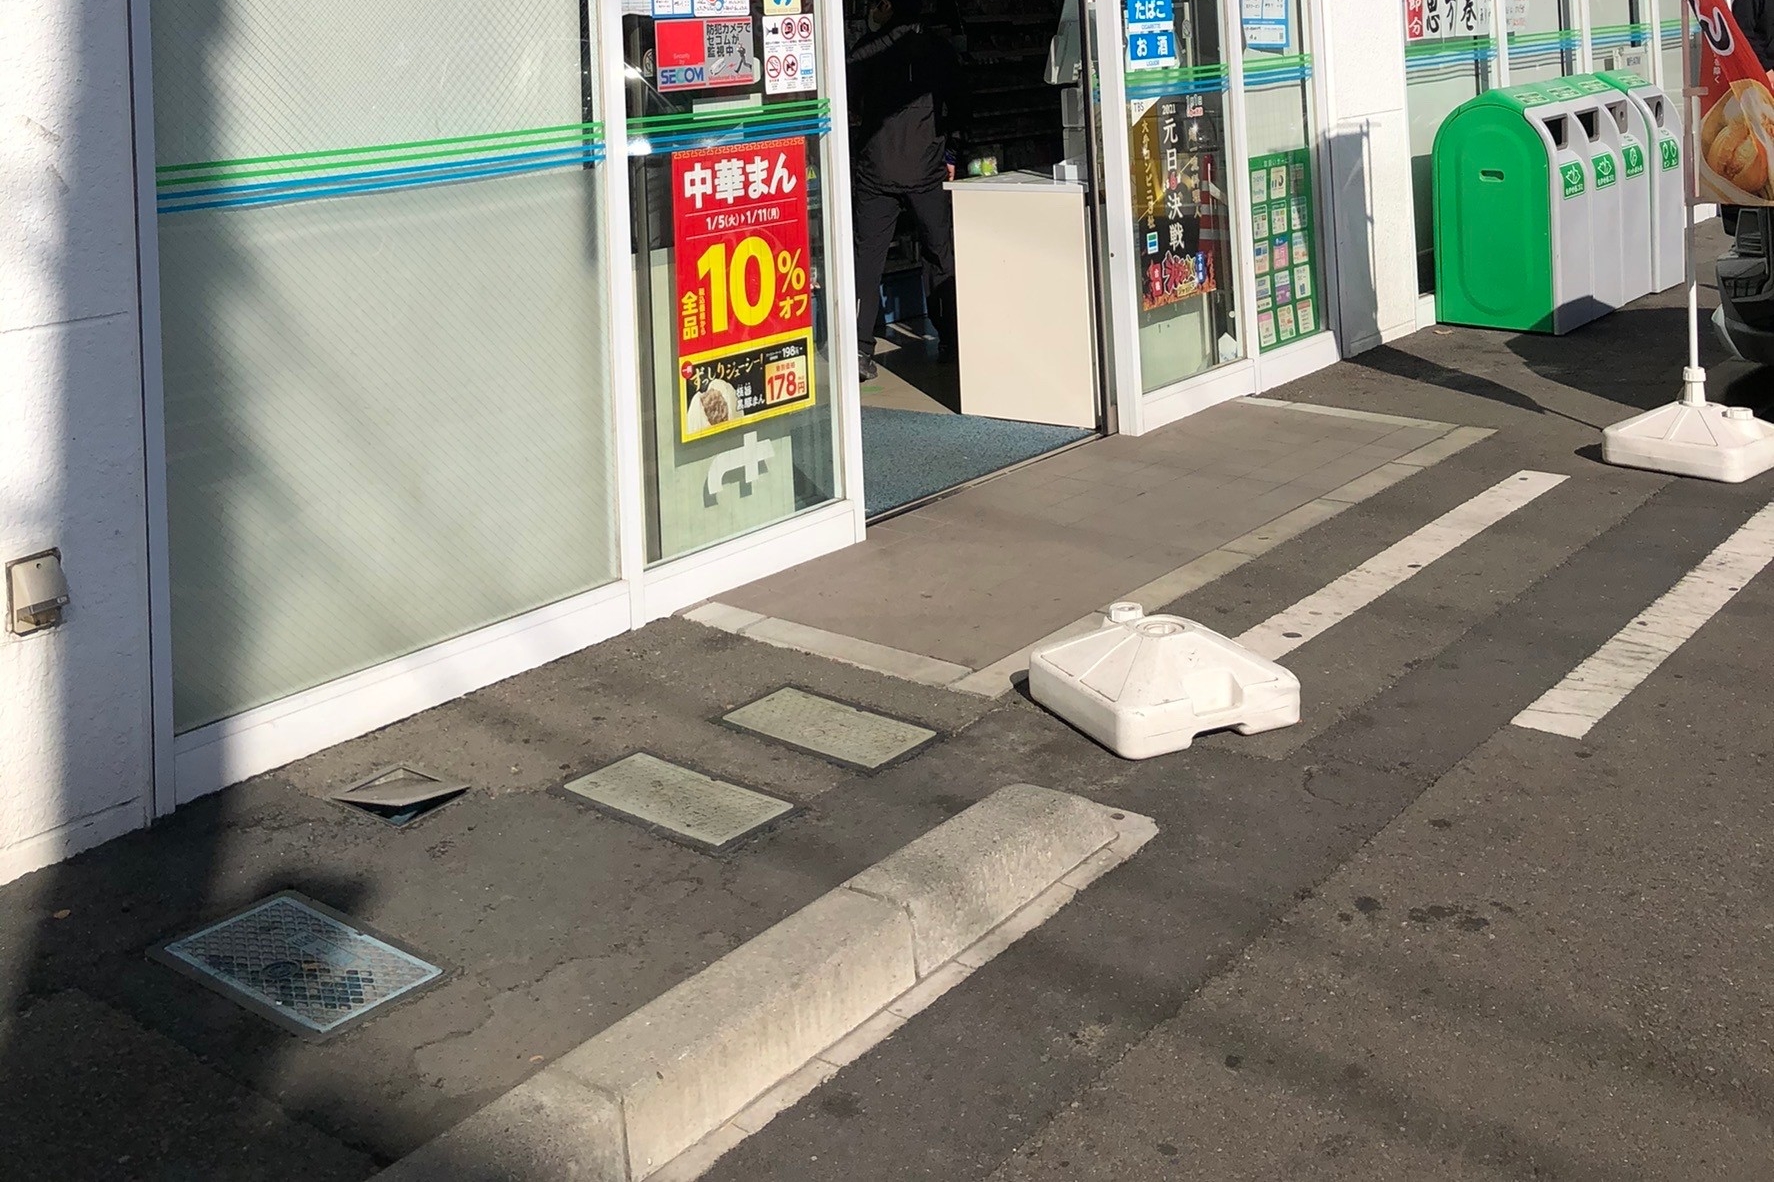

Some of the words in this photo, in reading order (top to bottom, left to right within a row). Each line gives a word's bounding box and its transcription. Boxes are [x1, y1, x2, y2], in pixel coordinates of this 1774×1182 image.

[1135, 0, 1167, 20] たばこ
[706, 22, 752, 36] 防犯カメラで
[707, 34, 740, 46] セコムが
[1136, 36, 1168, 57] お酒
[707, 45, 734, 58] 監視中
[660, 67, 705, 85] SECOM
[1161, 103, 1177, 115] 2021
[684, 153, 797, 208] 中華まん
[681, 290, 699, 341] 全品
[779, 294, 808, 319] オフ
[767, 370, 797, 401] 178
